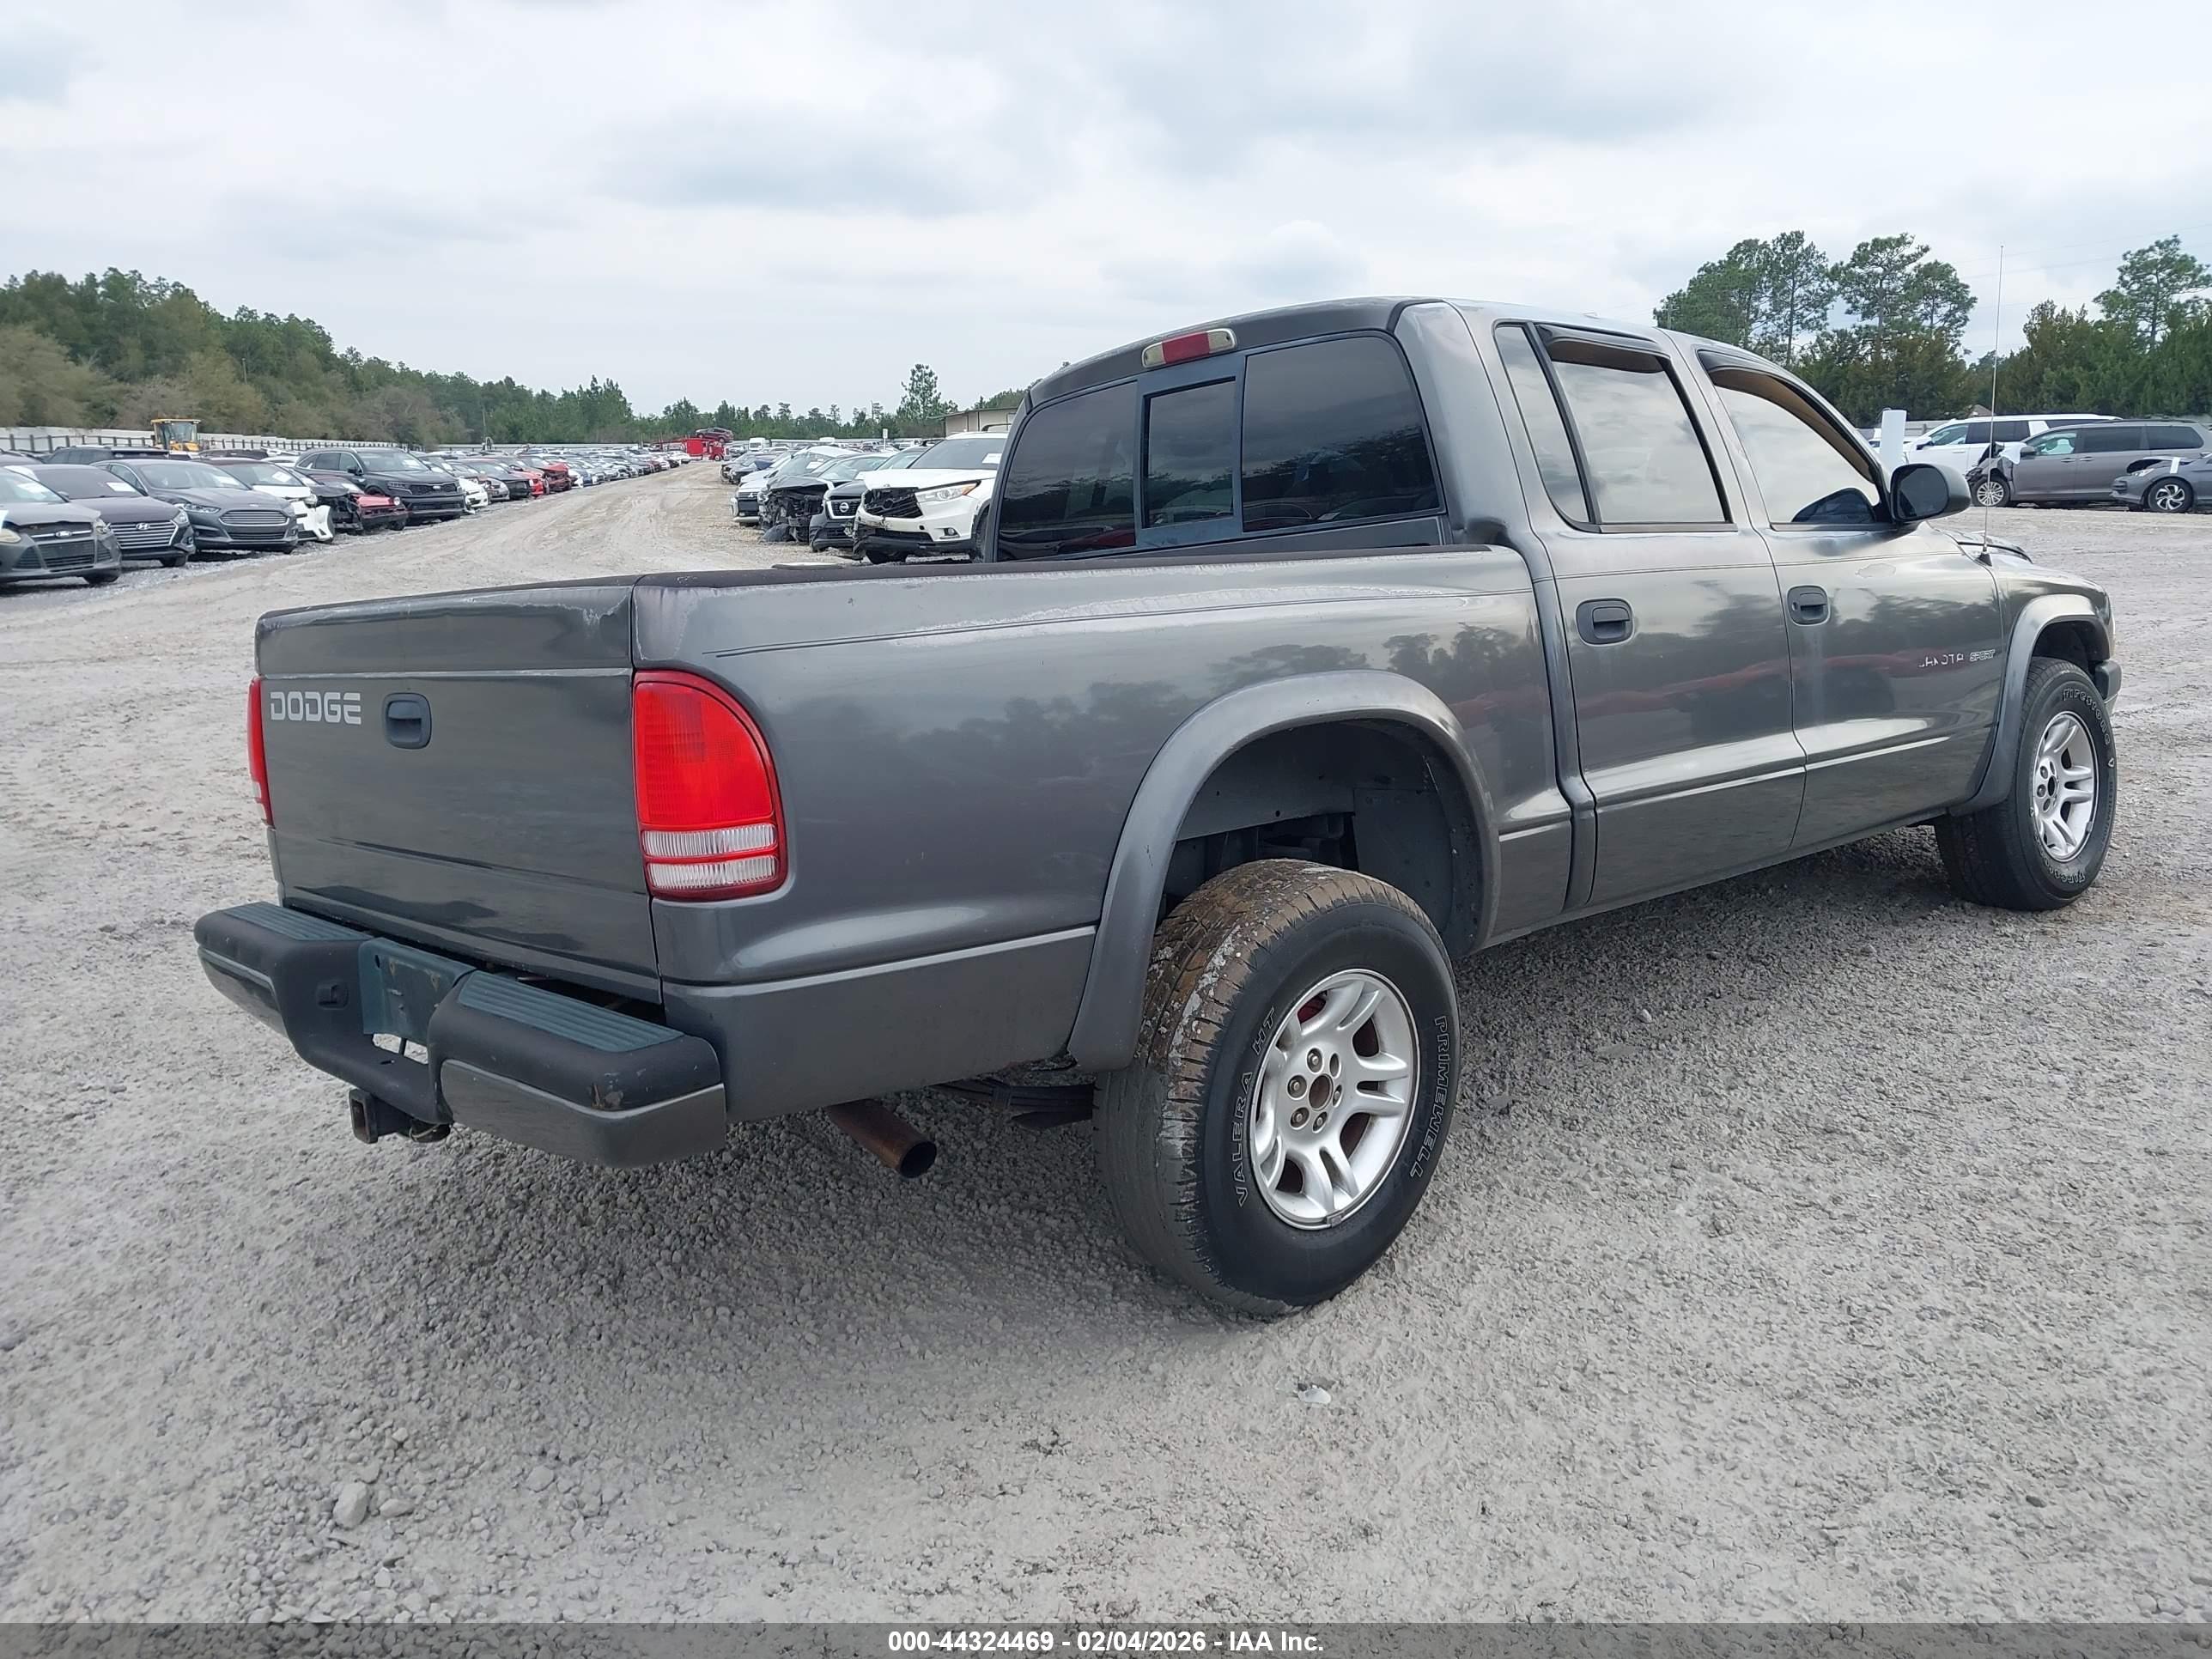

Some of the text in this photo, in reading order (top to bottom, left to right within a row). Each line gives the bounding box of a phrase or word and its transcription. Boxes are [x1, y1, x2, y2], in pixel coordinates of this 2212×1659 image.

[1969, 648, 1996, 662] SPORT
[270, 691, 362, 725] DODGE
[1232, 1006, 1275, 1207] VALERA HT
[1409, 1015, 1450, 1177] PRIMEWELL
